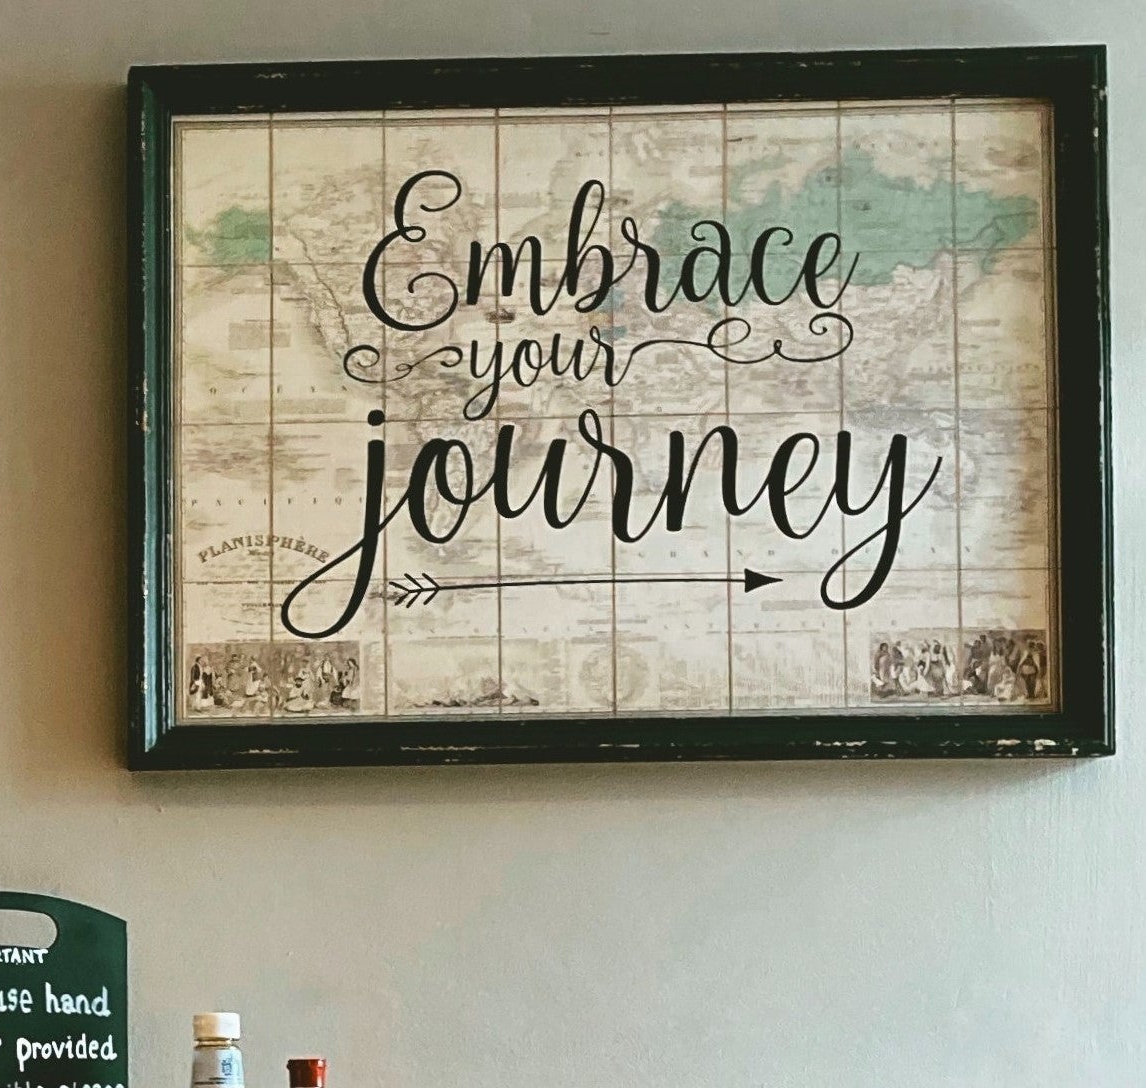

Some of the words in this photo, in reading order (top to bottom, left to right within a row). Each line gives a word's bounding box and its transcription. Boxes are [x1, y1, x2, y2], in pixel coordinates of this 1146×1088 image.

[362, 169, 860, 332] Embrace
[462, 325, 634, 421] your
[280, 409, 944, 641] journey
[45, 980, 112, 1018] hand
[16, 1032, 118, 1073] provided
